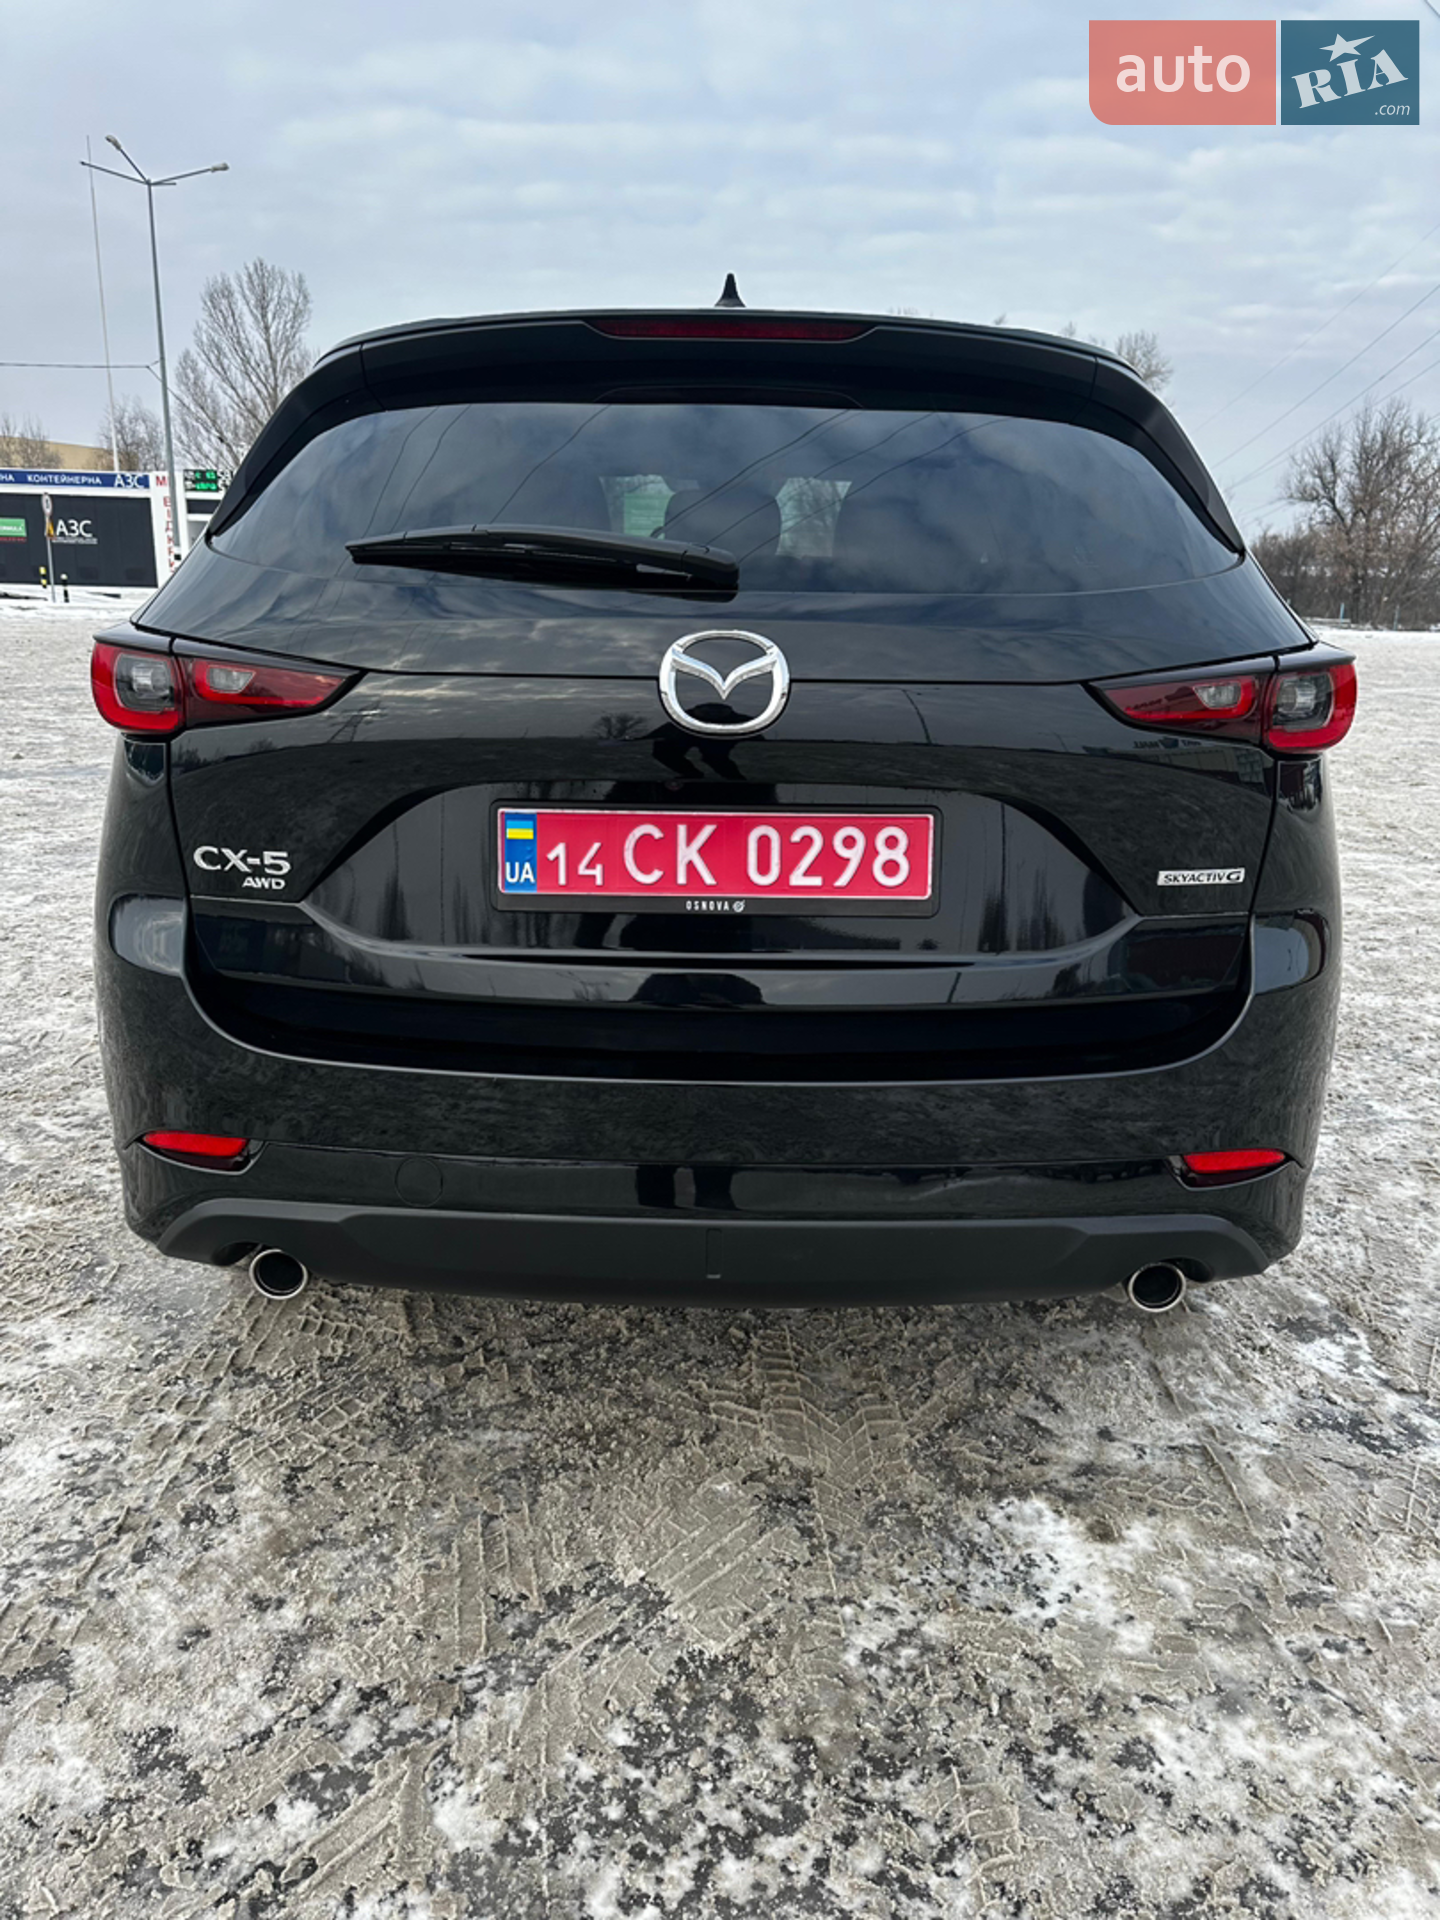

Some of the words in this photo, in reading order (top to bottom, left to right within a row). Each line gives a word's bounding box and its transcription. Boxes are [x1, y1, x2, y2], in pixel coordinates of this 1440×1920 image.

[113, 473, 145, 488] АЗС
[56, 519, 93, 538] АЗС
[193, 845, 292, 876] CX-5
[546, 842, 605, 887] 14
[623, 824, 718, 886] CK
[746, 825, 911, 888] 0298
[505, 862, 536, 884] UA
[241, 876, 286, 890] AWD
[685, 900, 730, 911] OSNOVA
